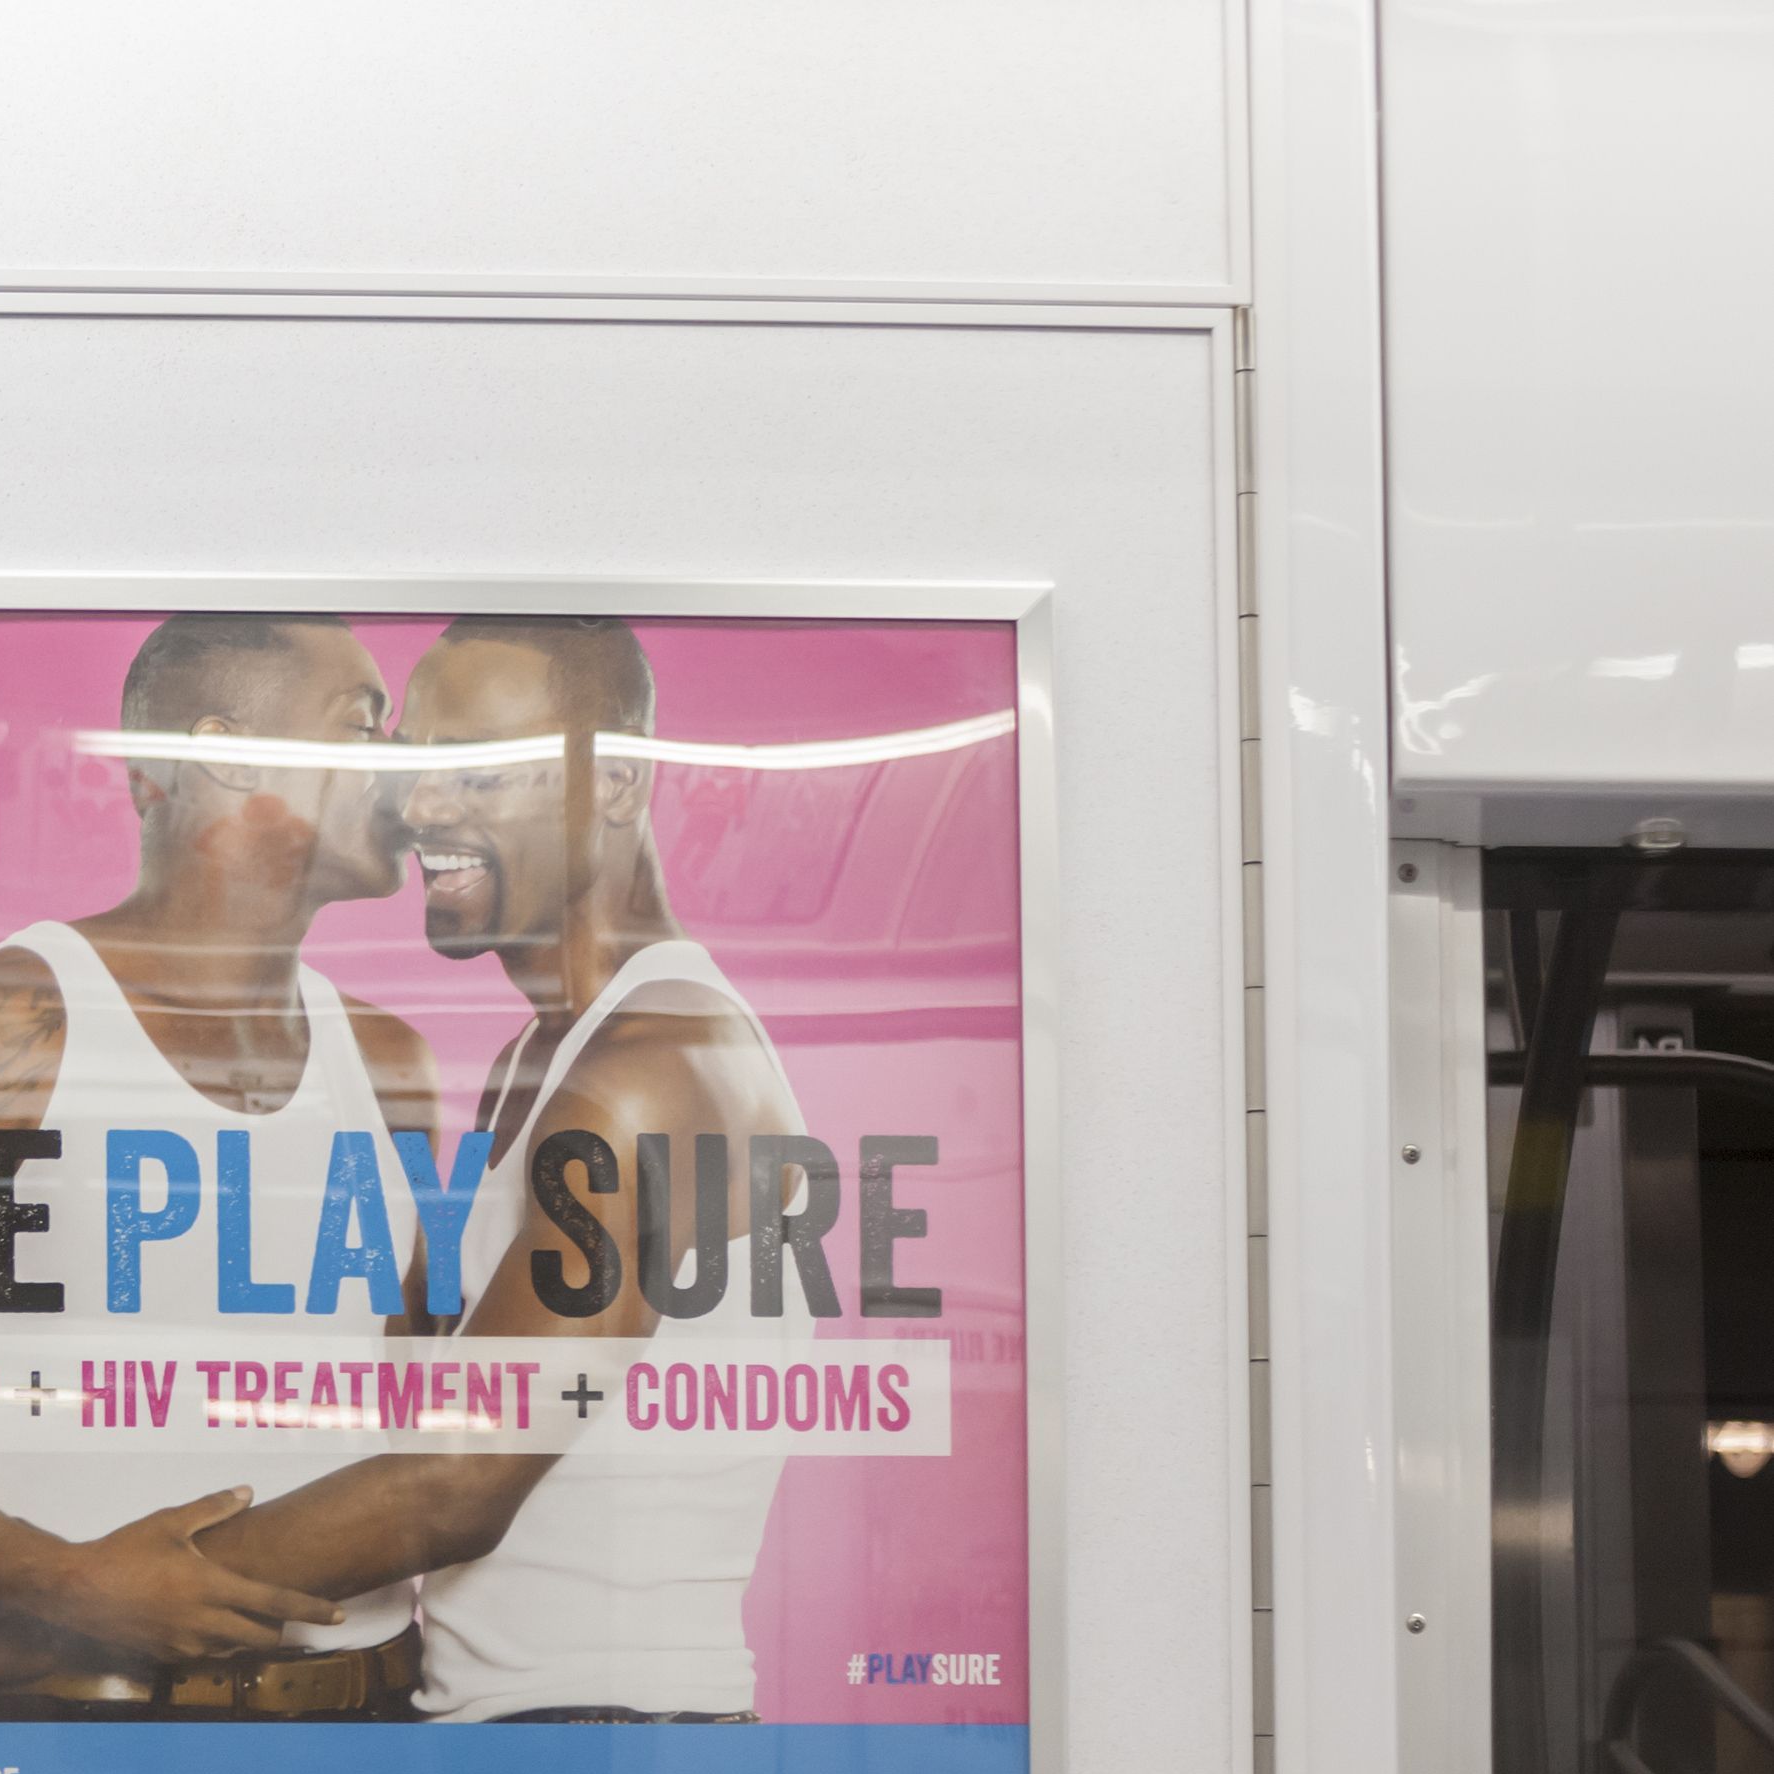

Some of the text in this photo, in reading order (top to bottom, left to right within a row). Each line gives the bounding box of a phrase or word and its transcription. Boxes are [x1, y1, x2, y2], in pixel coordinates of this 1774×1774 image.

[105, 1128, 496, 1316] PLAY
[529, 1128, 944, 1320] SURE
[81, 1360, 178, 1428] HIV
[195, 1360, 541, 1430] TREATMENT
[560, 1372, 605, 1420] +
[625, 1361, 912, 1433] CONDOMS
[846, 1652, 1002, 1686] #PLAYSURE
